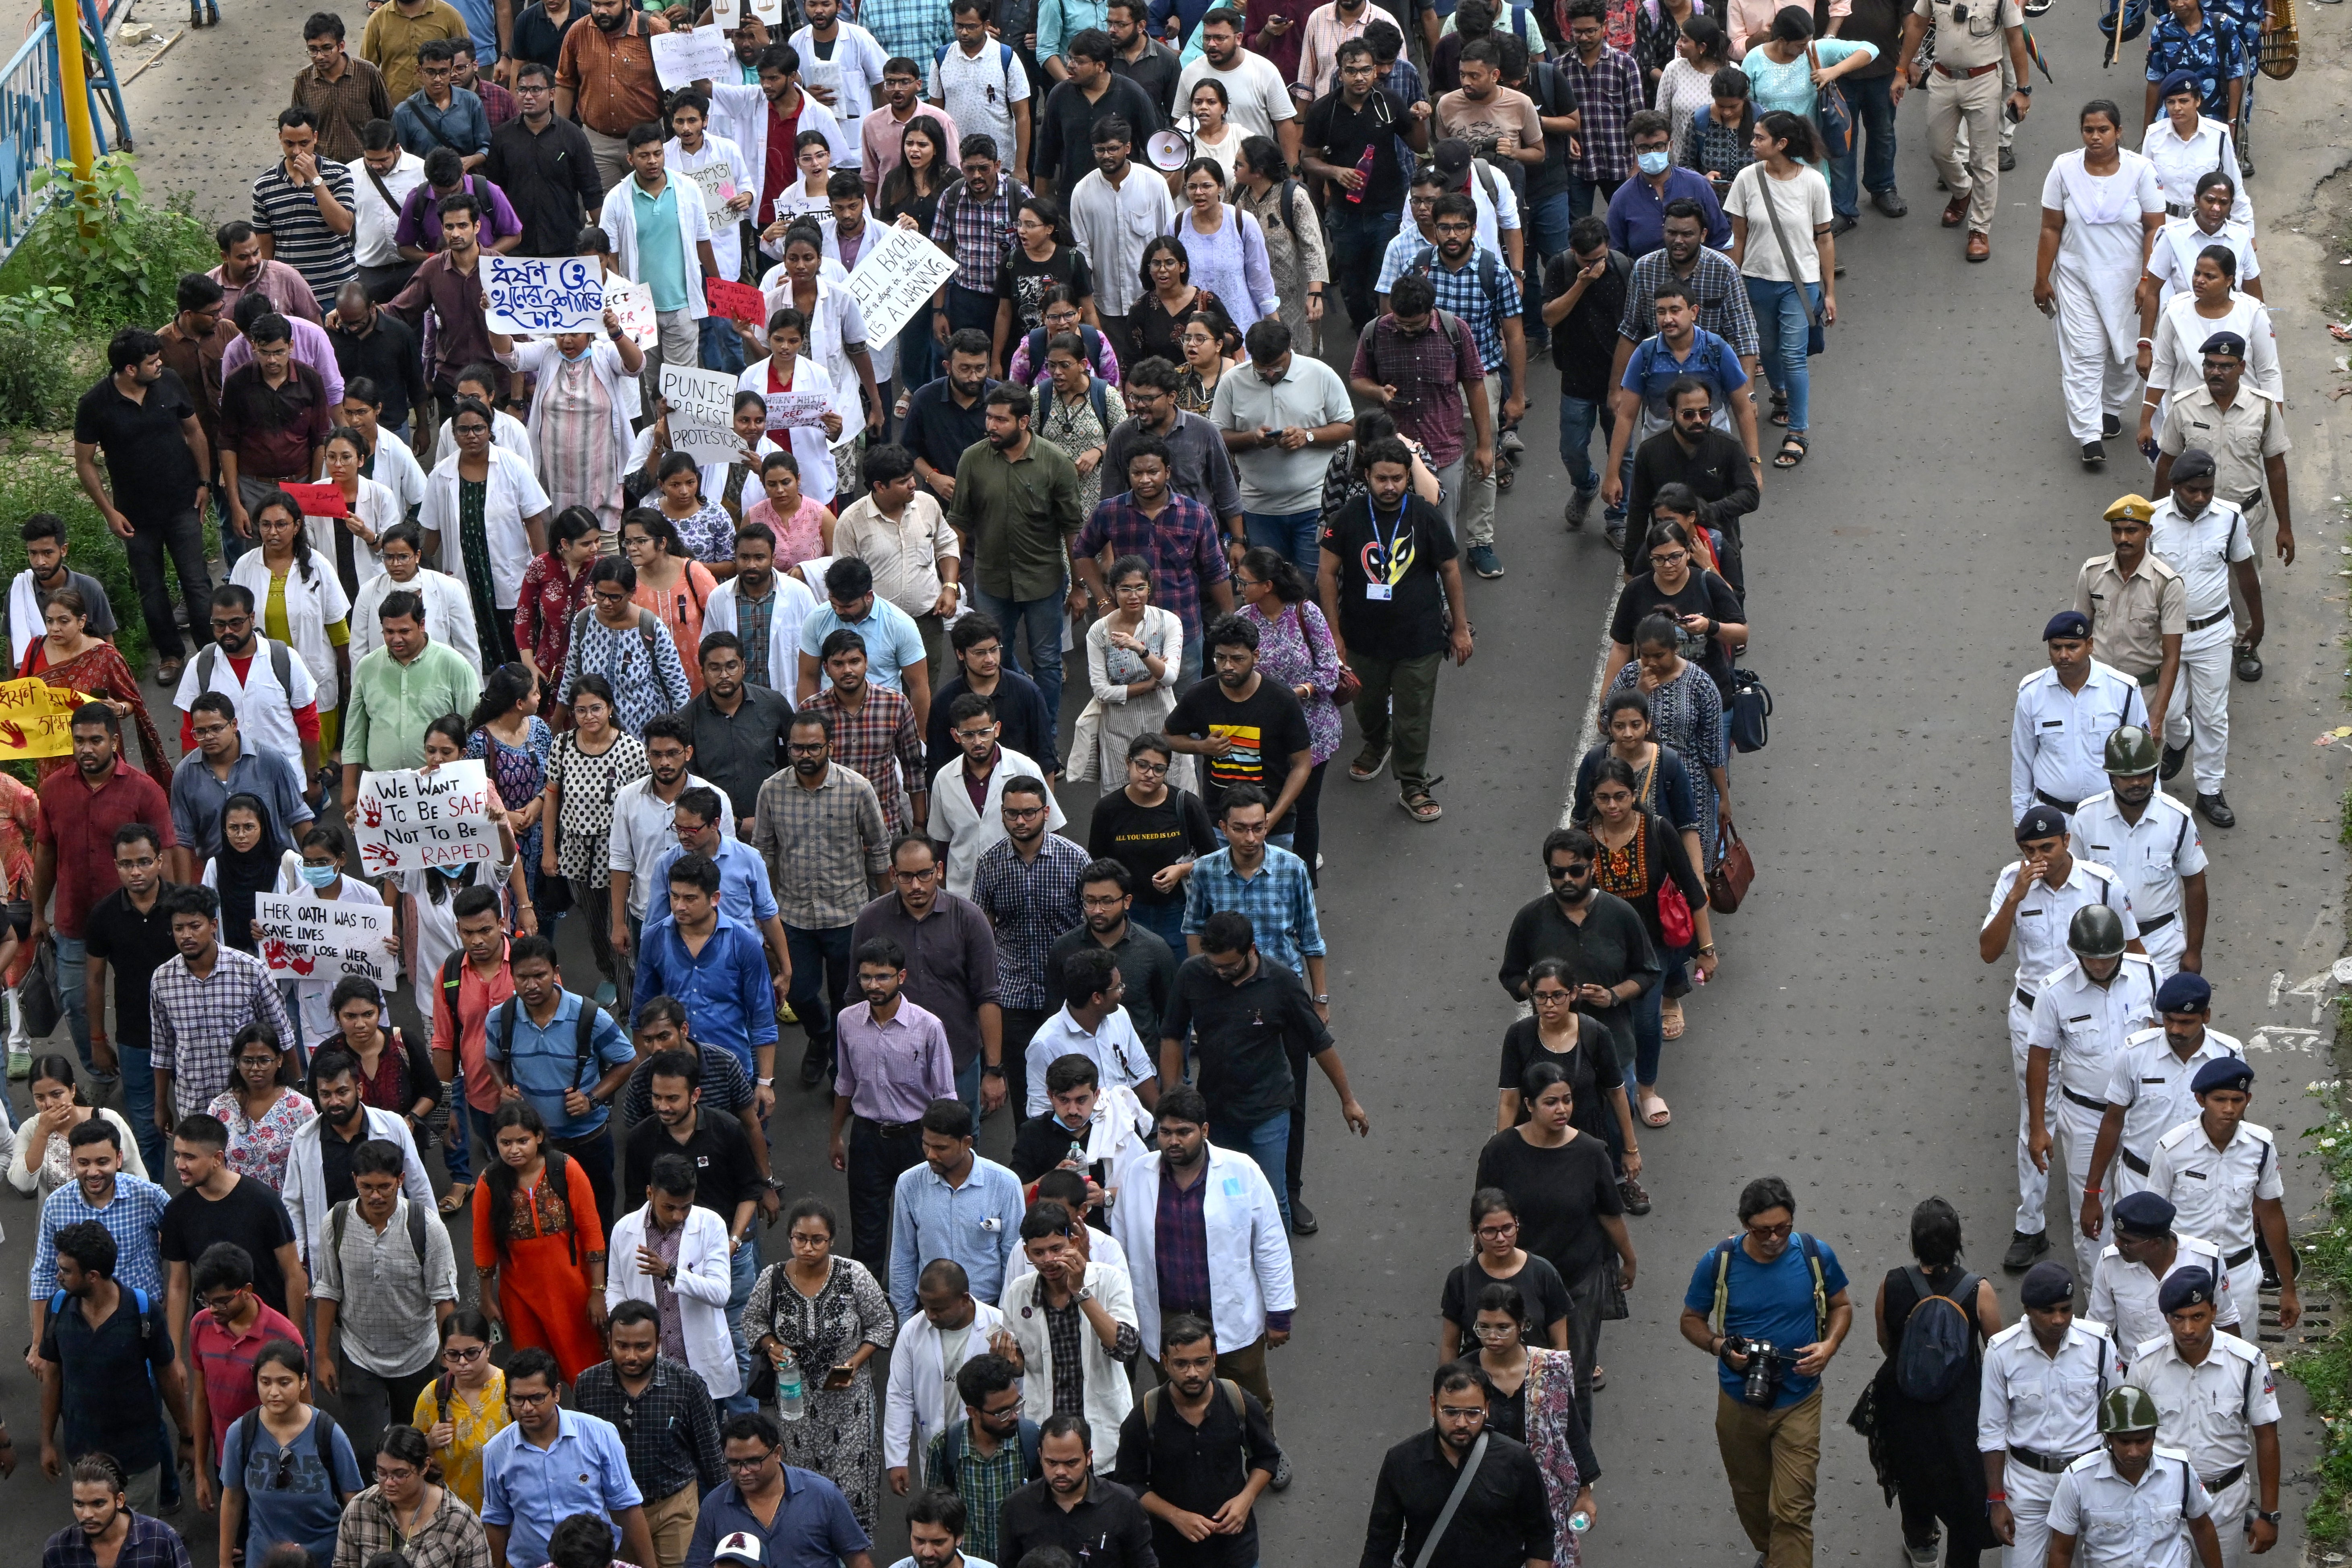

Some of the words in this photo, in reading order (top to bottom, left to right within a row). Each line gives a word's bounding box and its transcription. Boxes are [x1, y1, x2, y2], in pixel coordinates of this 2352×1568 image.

[775, 200, 792, 211] They
[796, 199, 810, 209] Say
[491, 259, 551, 285] ধর্ষণ
[559, 259, 586, 289] ও
[892, 278, 901, 286] in
[895, 258, 951, 308] WARNING
[730, 286, 748, 295] TELL
[849, 271, 878, 306] ETI
[523, 304, 585, 329] চাই
[887, 306, 905, 322] A
[665, 373, 736, 408] PUNISH
[765, 396, 791, 404] WHEN
[796, 393, 828, 404] WHITE
[782, 410, 803, 419] RED
[792, 404, 824, 413] TURNS
[673, 429, 748, 450] PROTESTORS
[375, 778, 409, 799] WE
[415, 776, 459, 796] WANT
[384, 804, 406, 822] TO
[417, 801, 438, 820] BE
[384, 828, 419, 845] NOT
[425, 825, 450, 840] TO
[457, 822, 477, 838] BE
[422, 843, 490, 866] RAPED
[264, 901, 293, 922] HER
[298, 907, 327, 925] OATH
[335, 911, 356, 928] WAS
[262, 923, 293, 939] SAVE
[298, 926, 324, 941] LIVES
[287, 944, 309, 955] NOT
[314, 945, 338, 957] LOSE
[345, 948, 372, 966] HER
[341, 963, 383, 981] OWN!!!
